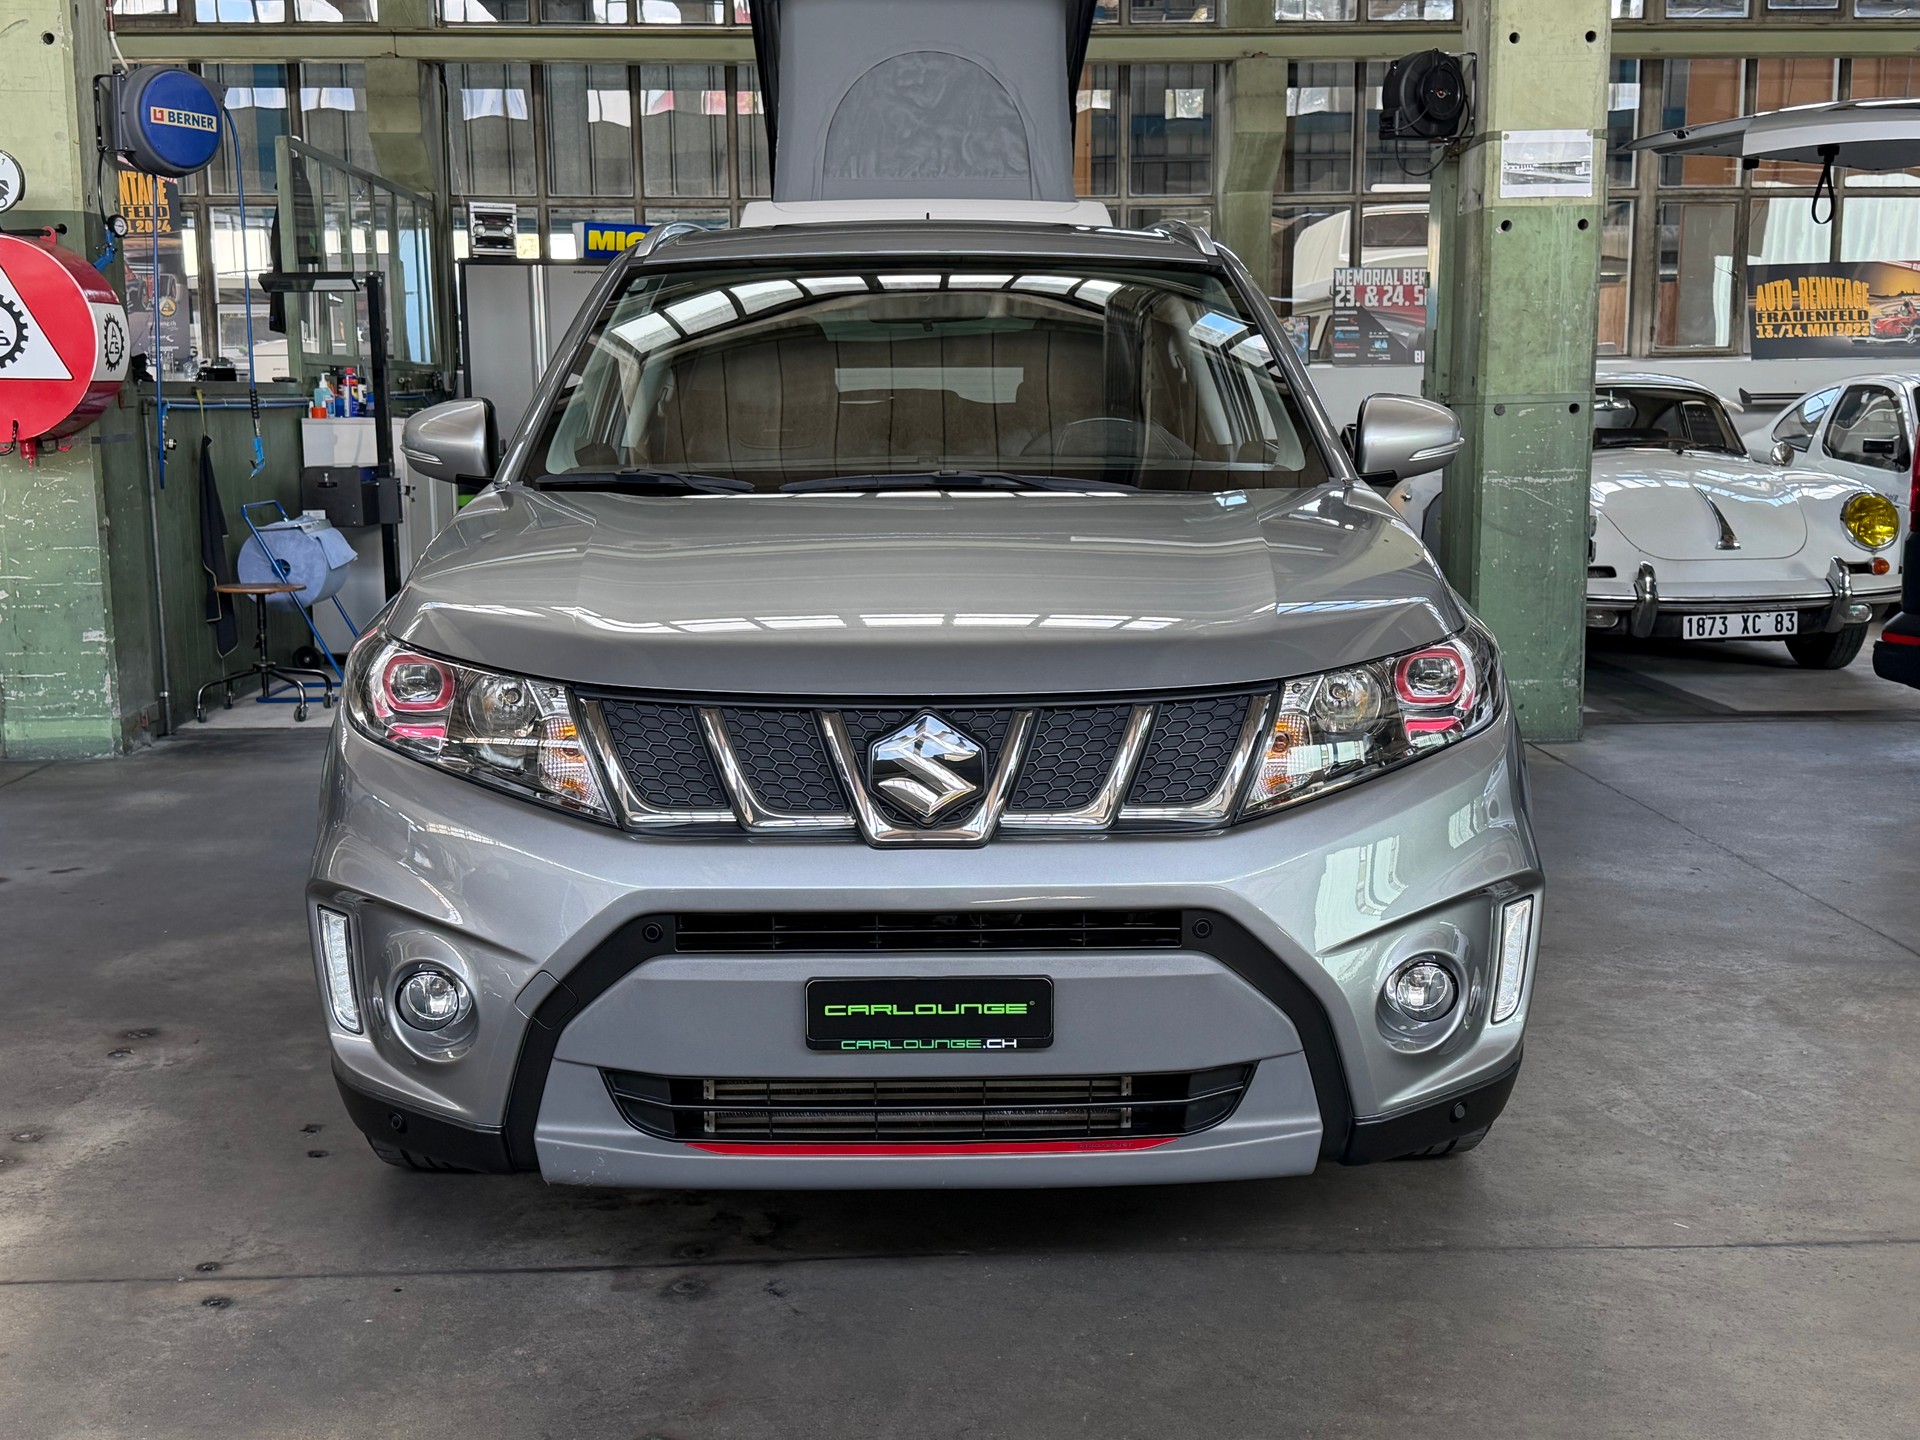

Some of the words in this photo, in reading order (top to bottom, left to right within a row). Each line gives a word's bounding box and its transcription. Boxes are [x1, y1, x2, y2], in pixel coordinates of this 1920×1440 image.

[167, 110, 214, 130] BERNER
[1335, 268, 1401, 286] MEMORIAL
[1334, 286, 1361, 307] 23.
[1364, 286, 1379, 307] &
[1382, 285, 1410, 307] 24.
[1413, 285, 1427, 306] S
[1756, 276, 1870, 311] AUTO-RENNTAGE
[1757, 310, 1869, 323] FRAUENFELD
[1836, 323, 1870, 337] 2023
[1414, 350, 1425, 363] B
[1687, 616, 1728, 637] 1873
[1741, 615, 1762, 635] XC
[1774, 613, 1795, 633] 83
[824, 1002, 1028, 1016] CARLOUNGE
[840, 1037, 1017, 1050] CARLOUNGE.CH
